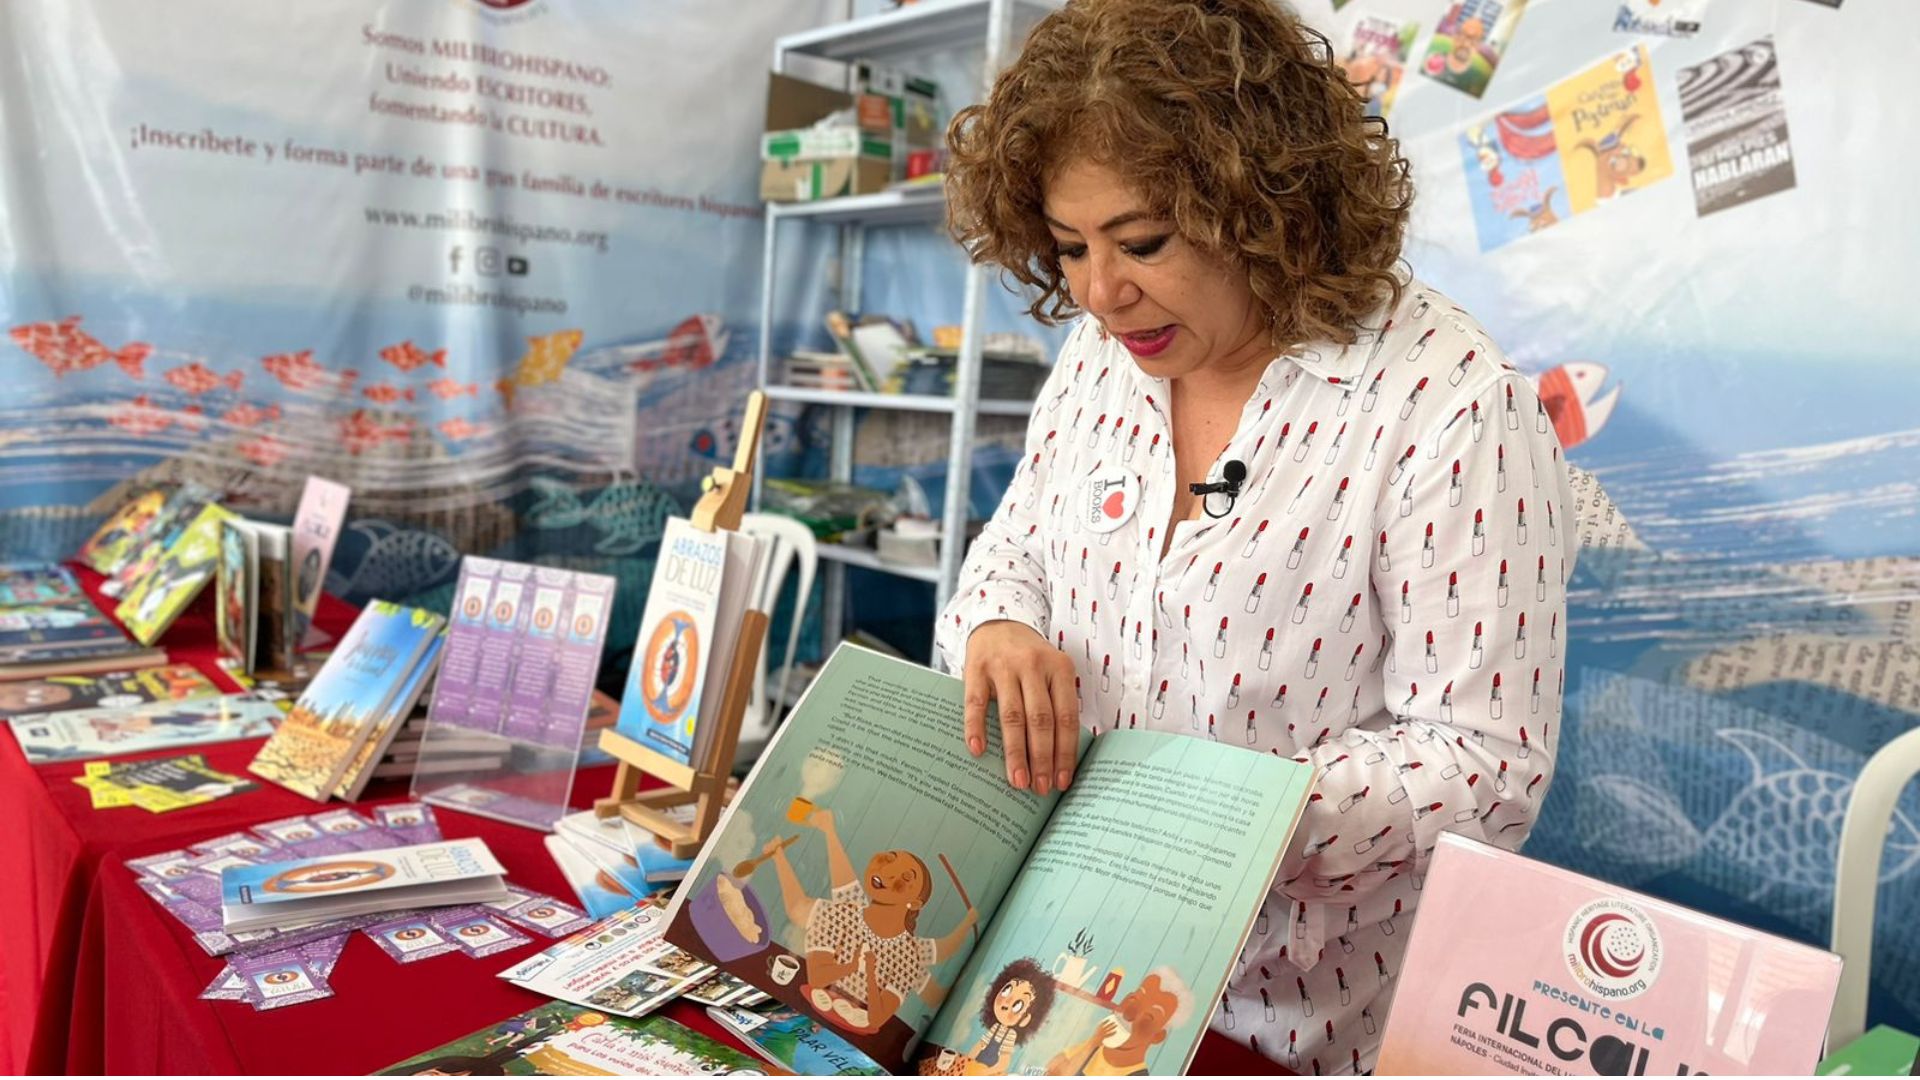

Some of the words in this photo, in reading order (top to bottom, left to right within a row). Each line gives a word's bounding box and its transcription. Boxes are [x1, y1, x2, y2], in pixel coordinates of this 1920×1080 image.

[362, 24, 426, 54] Somos
[386, 62, 471, 93] Uniendo
[264, 143, 277, 164] y
[284, 137, 349, 168] forma
[355, 151, 405, 174] parte
[410, 155, 435, 179] de
[442, 162, 480, 182] una
[521, 169, 585, 198] familia
[589, 178, 612, 200] de
[615, 184, 696, 212] escritores
[1104, 476, 1126, 491] I
[1090, 480, 1103, 523] BOOKS
[672, 536, 723, 567] ABRAZOS
[1450, 1034, 1488, 1058] NÁPOLES
[1452, 1022, 1478, 1041] FERIA
[1477, 1030, 1544, 1071] INTERNACIONAL
